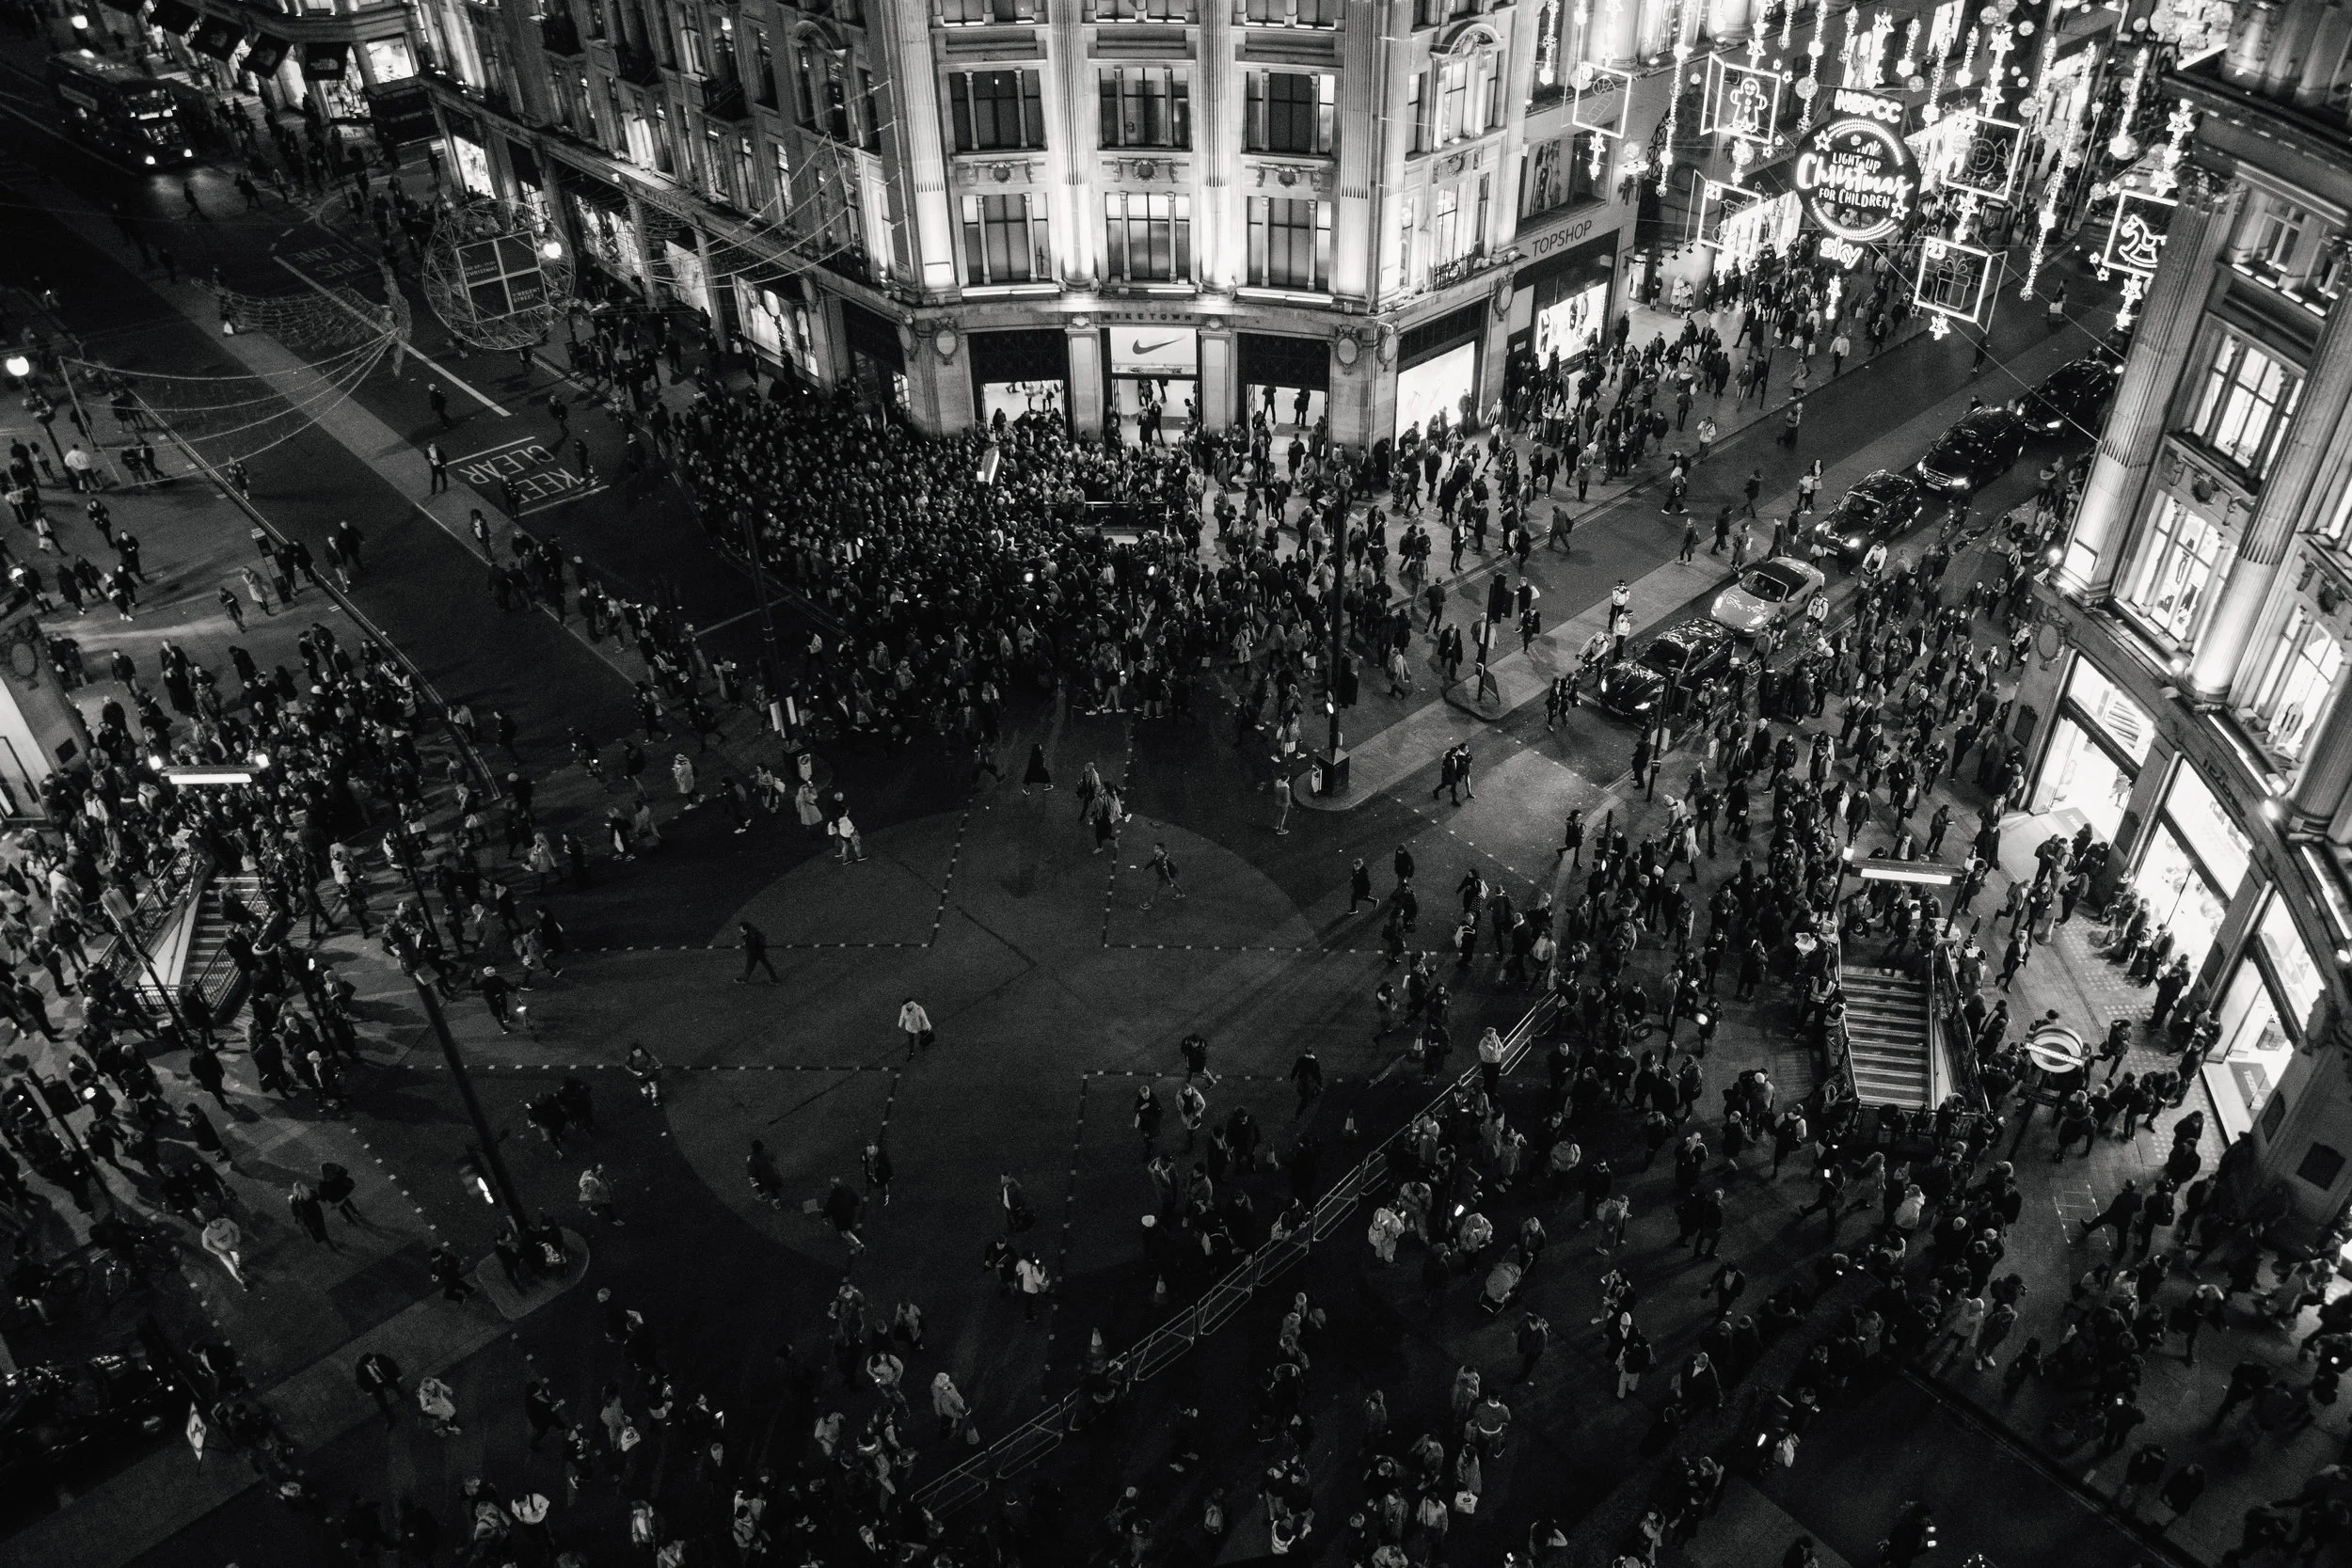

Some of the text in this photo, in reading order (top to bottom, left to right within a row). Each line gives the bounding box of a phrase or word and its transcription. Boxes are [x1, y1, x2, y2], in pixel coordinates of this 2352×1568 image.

[1835, 89, 1903, 123] NSPCC
[1796, 152, 1914, 195] Christmas
[1832, 151, 1882, 174] LIGHT UP
[1819, 187, 1891, 209] FOR CHILDREN
[1532, 220, 1593, 258] TOPSHOP
[1820, 236, 1864, 270] sky
[1104, 313, 1192, 322] NIKETOWN
[457, 445, 556, 484] CLEAR
[2026, 1043, 2082, 1065] UNDERGROUND
